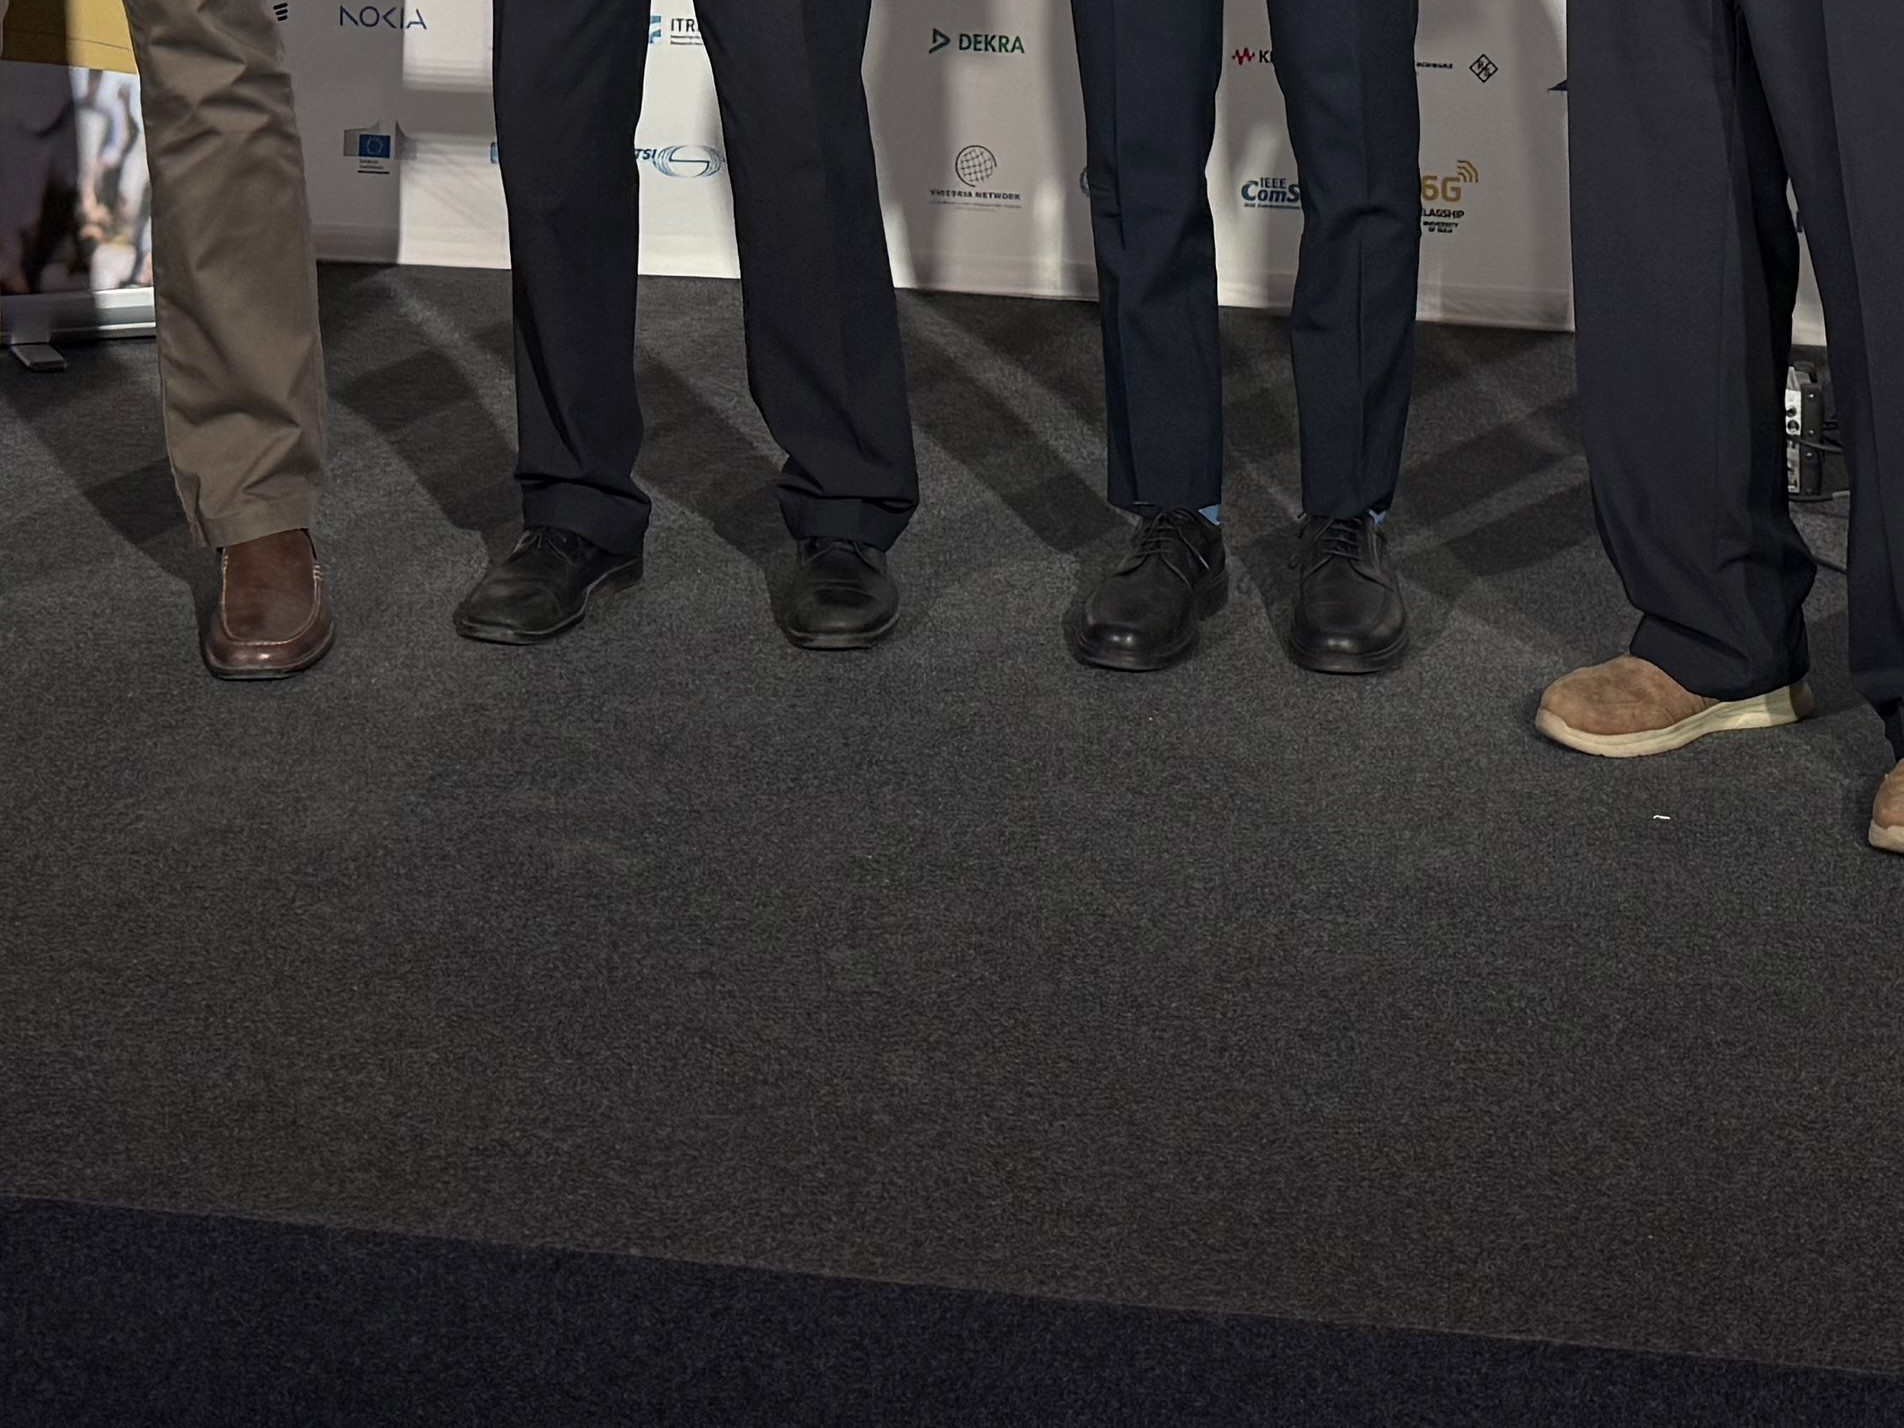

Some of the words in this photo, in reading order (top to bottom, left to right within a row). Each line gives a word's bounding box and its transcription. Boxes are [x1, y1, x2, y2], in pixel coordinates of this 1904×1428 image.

[340, 5, 427, 30] NOKIA
[958, 33, 1025, 54] DEKRA
[633, 148, 657, 161] TSI
[1260, 177, 1287, 189] IEEE
[1422, 175, 1462, 202] 6G
